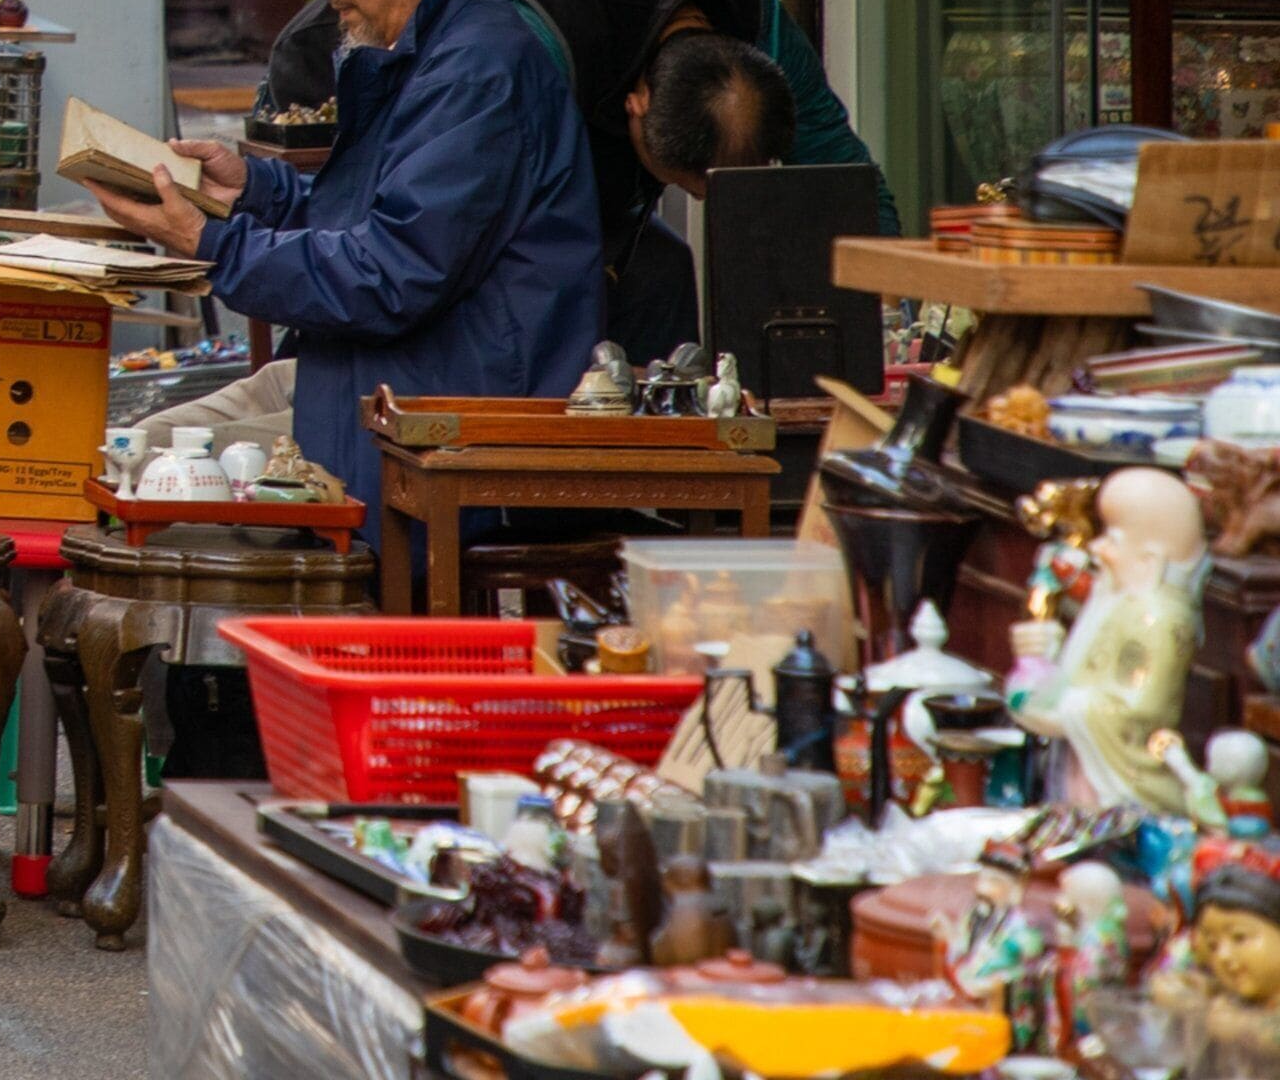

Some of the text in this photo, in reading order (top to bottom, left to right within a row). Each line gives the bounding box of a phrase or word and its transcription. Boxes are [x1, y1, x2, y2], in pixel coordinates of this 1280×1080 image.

[43, 320, 57, 340] L
[68, 322, 85, 340] 12
[15, 465, 26, 475] 12
[28, 466, 72, 478] Eggs/Tray
[28, 477, 78, 488] Trays/Case
